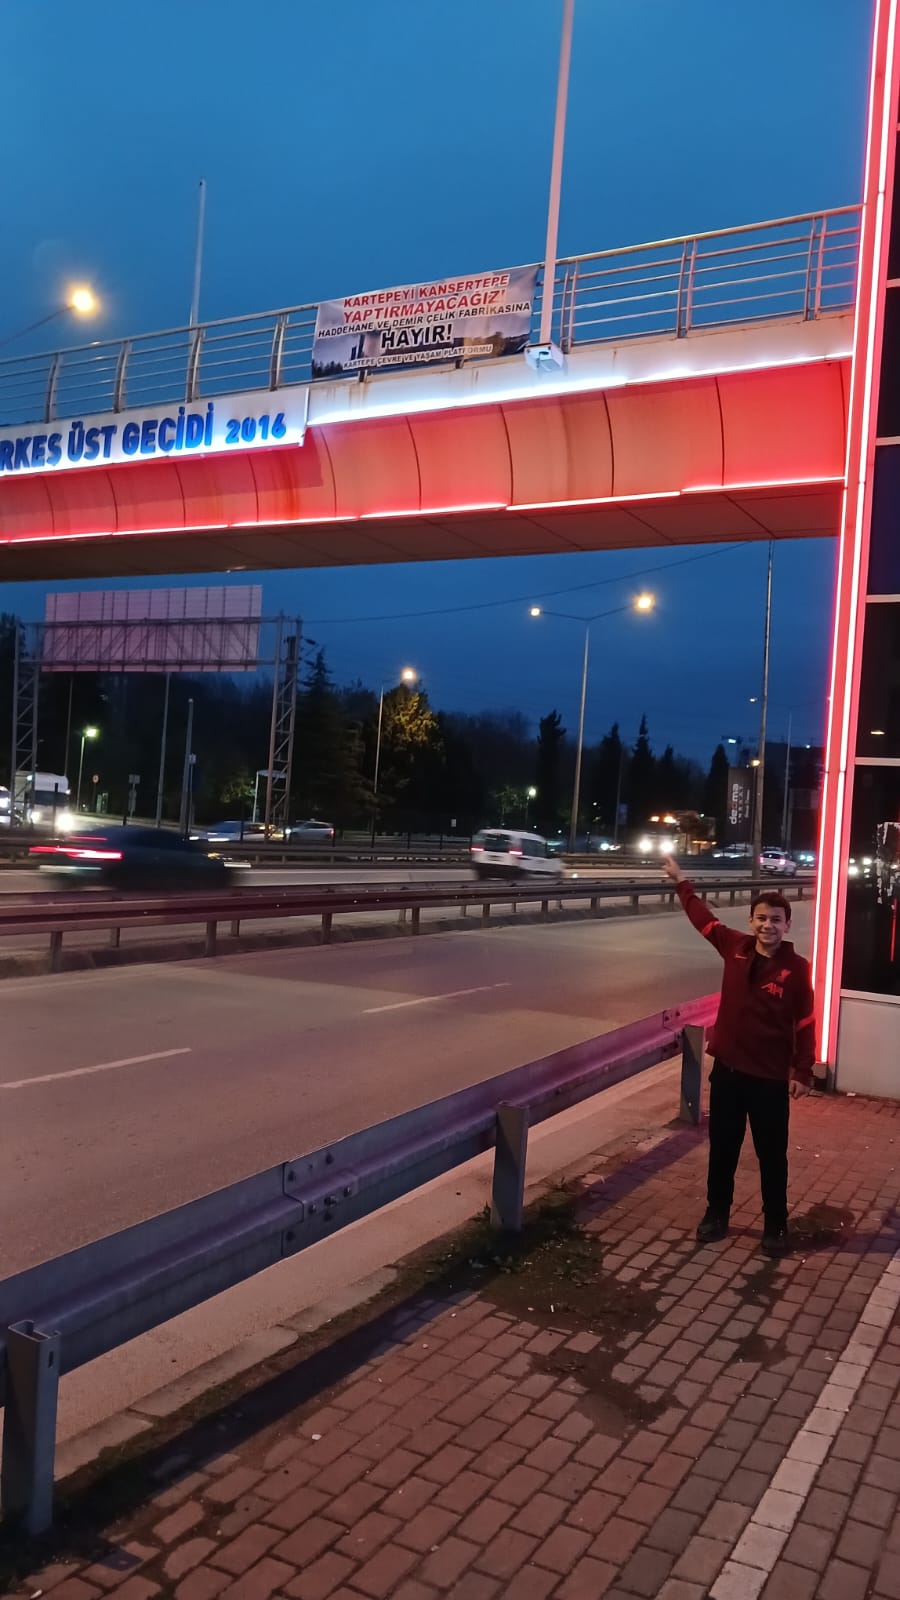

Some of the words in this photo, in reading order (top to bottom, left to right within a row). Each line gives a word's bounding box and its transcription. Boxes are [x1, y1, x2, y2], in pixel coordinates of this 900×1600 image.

[419, 275, 509, 298] KANSERTEPE
[318, 322, 374, 338] HADDEHANE
[377, 319, 391, 329] VE
[426, 310, 456, 324] ÇELİK
[458, 302, 530, 318] FABRİKASINA
[381, 323, 453, 349] HAYIR!
[343, 358, 376, 370] KARTEPE
[403, 354, 414, 363] VE
[0, 433, 62, 471] RKES
[67, 420, 118, 462] ÜST
[225, 412, 287, 444] 2016
